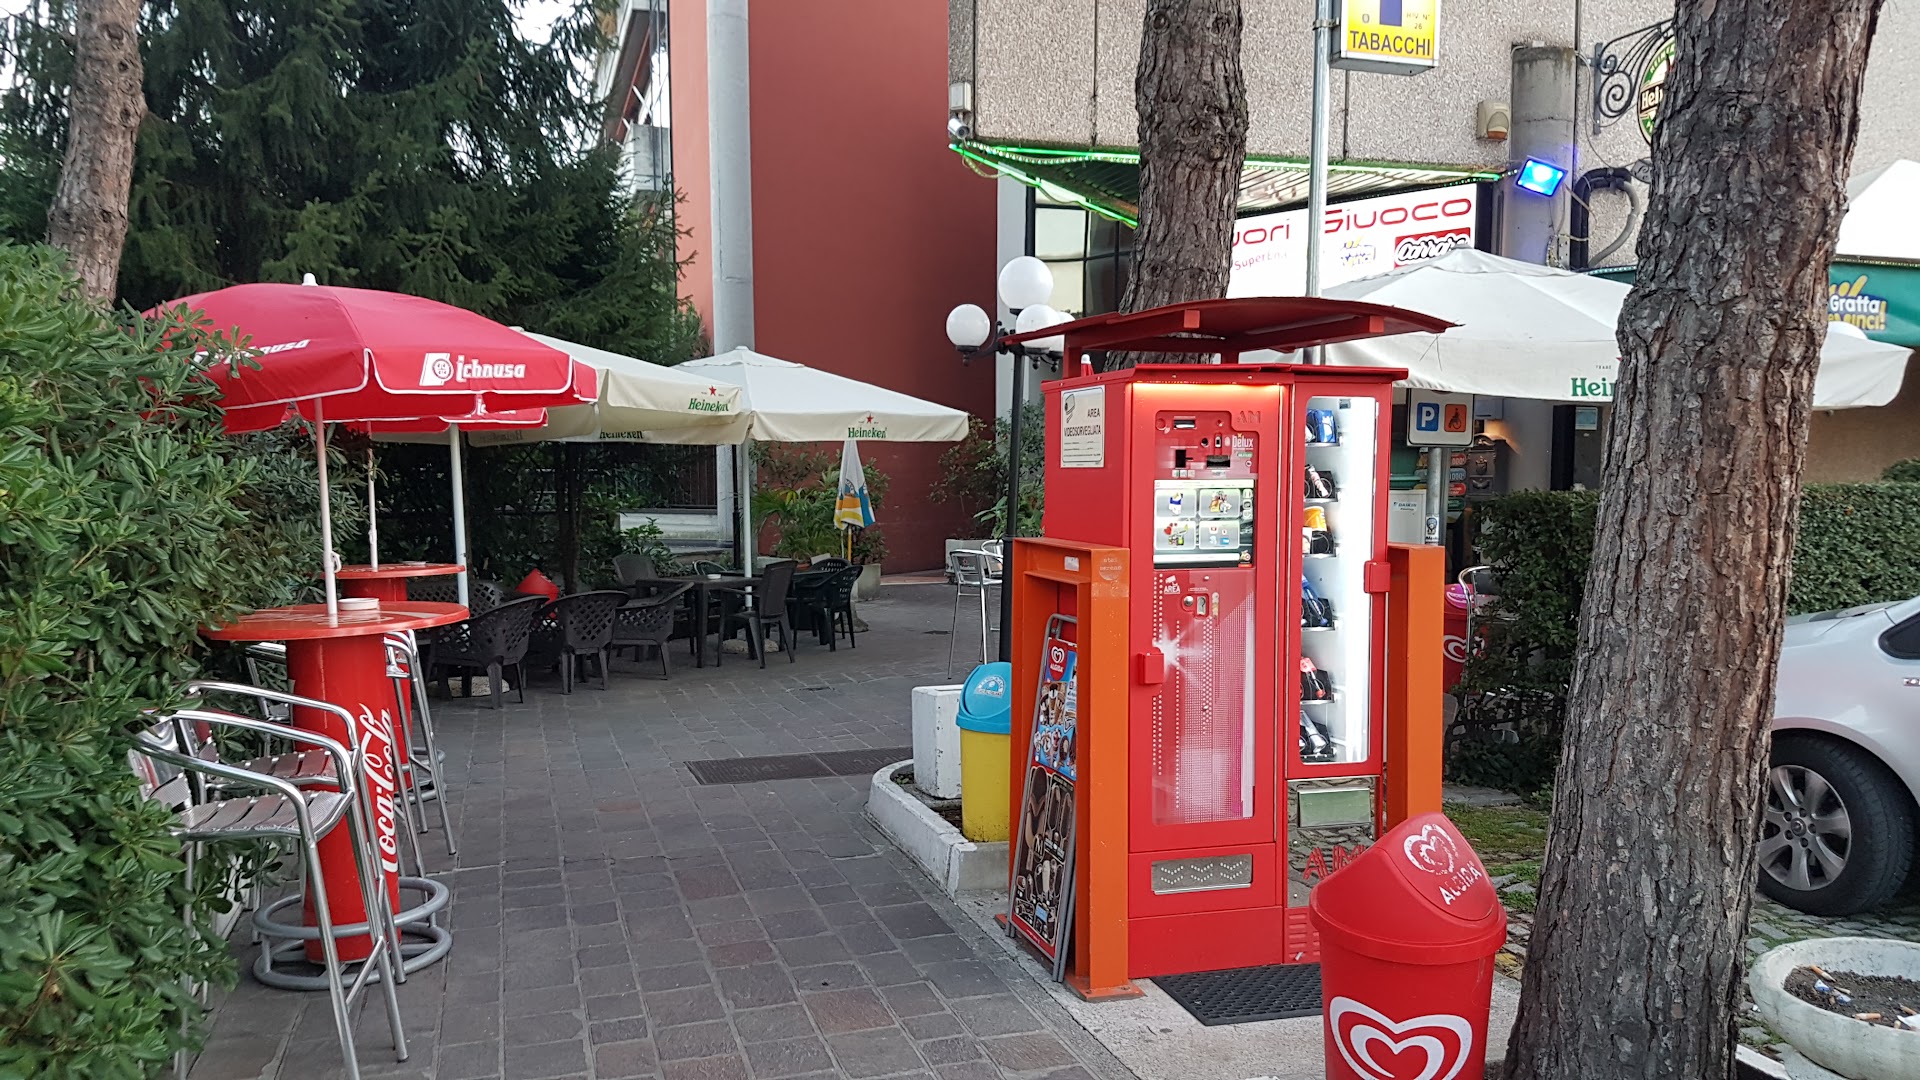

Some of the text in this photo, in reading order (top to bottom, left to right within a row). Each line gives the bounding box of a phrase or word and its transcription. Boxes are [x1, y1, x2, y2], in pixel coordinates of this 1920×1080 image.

[1350, 30, 1431, 56] TABACCHI
[1829, 295, 1880, 314] Gratta
[1087, 408, 1101, 418] AREA
[1421, 407, 1435, 428] P
[848, 427, 886, 438] Heineken
[1064, 424, 1102, 437] VIDEOSORVEGLIATA
[1164, 585, 1181, 595] AREA
